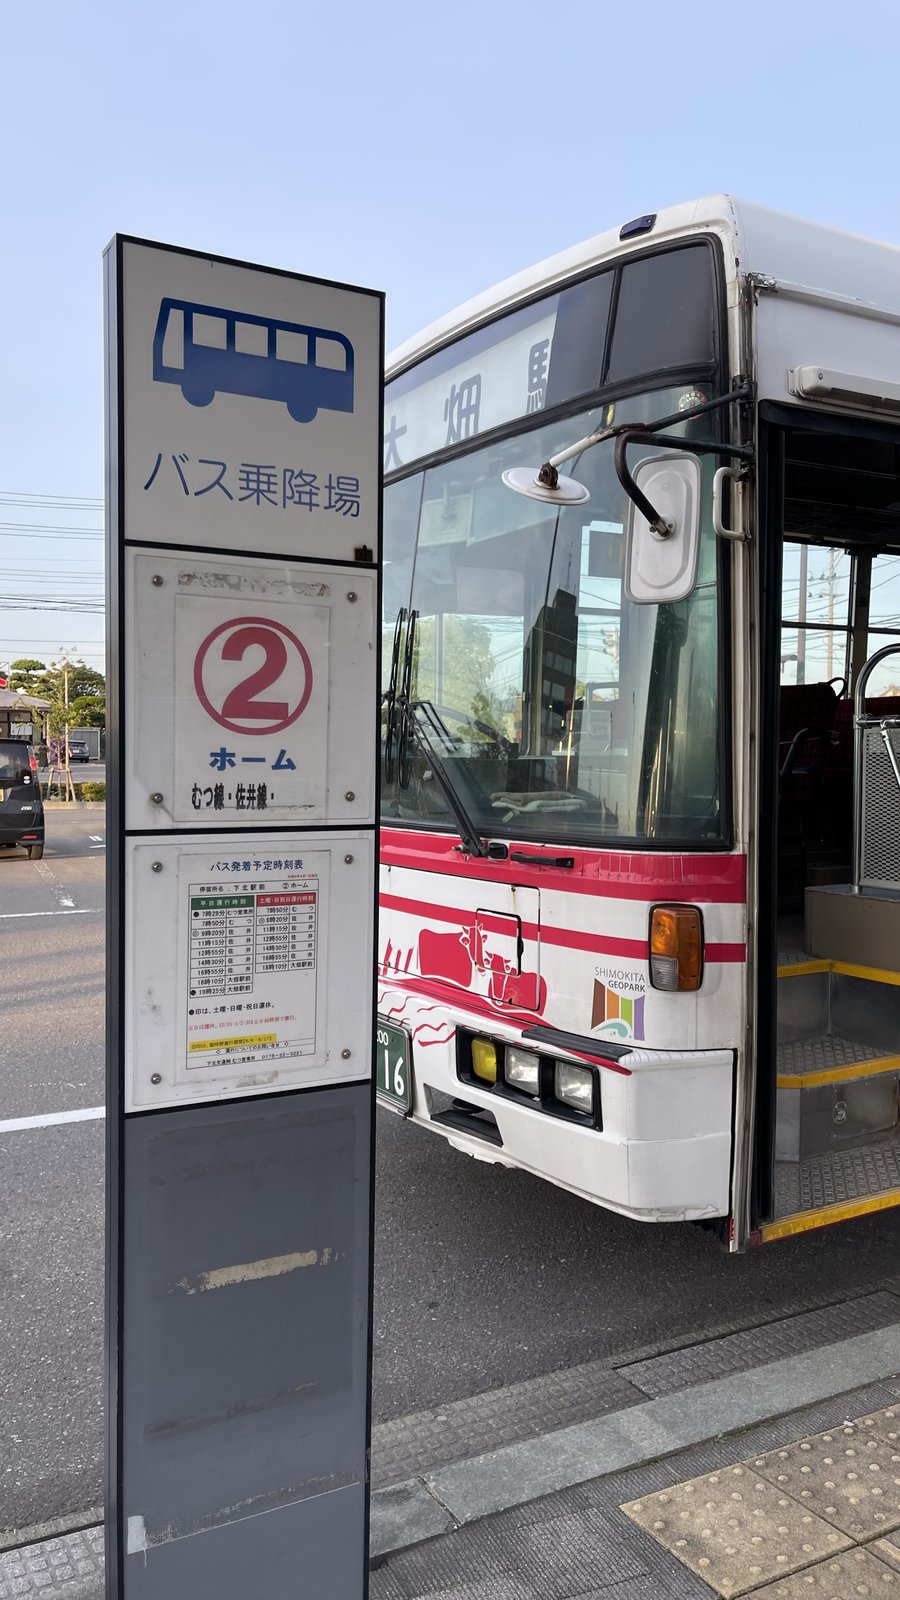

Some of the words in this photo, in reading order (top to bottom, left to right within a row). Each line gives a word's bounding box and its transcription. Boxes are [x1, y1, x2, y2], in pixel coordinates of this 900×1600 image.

[143, 453, 361, 518] バス乗降場
[208, 747, 297, 771] ホーム
[210, 859, 304, 872] バス発着予定時刻表
[594, 966, 646, 984] SHIMOKITA
[608, 979, 646, 993] GEOPARK
